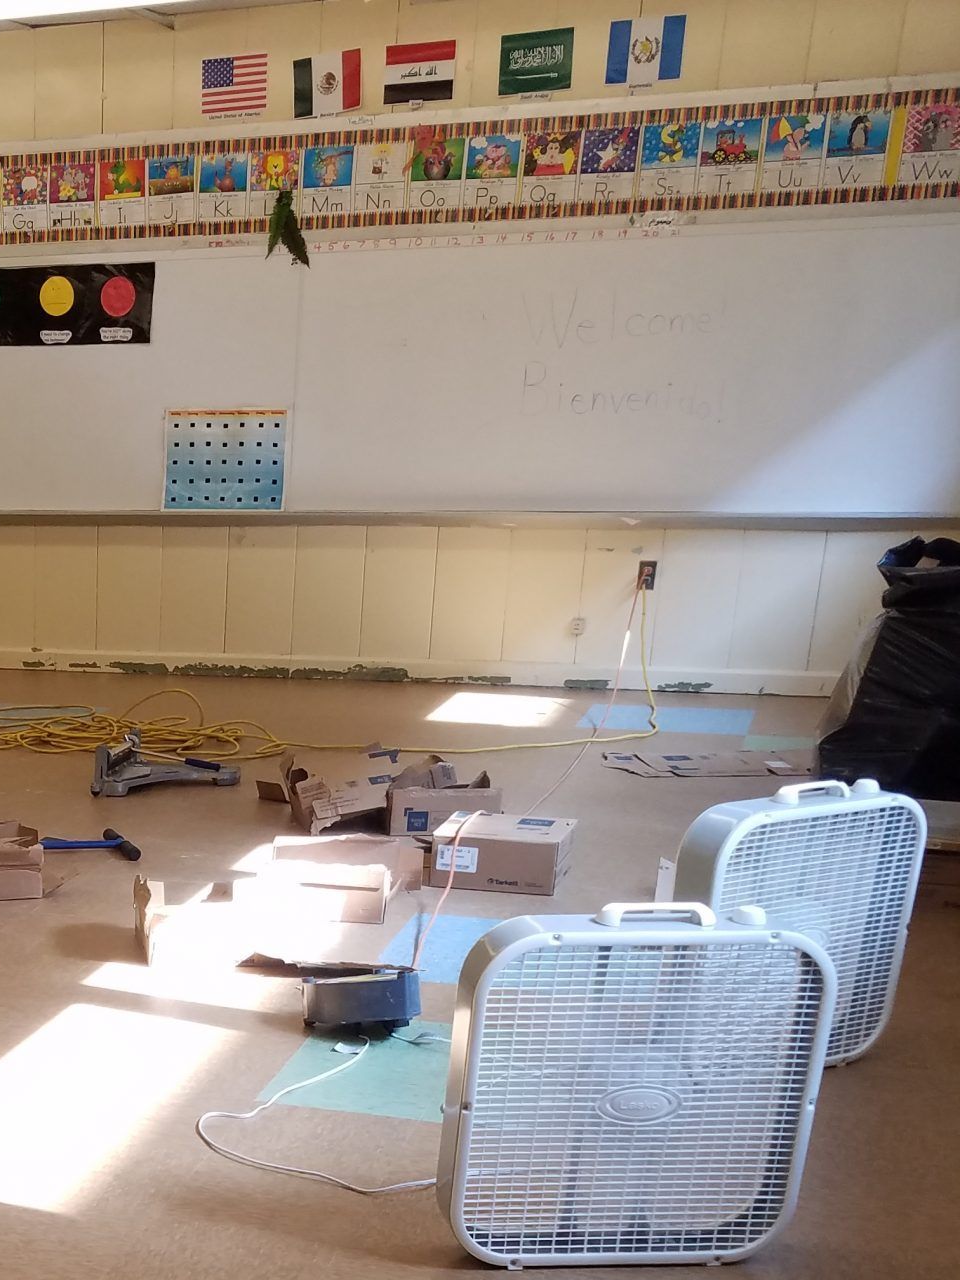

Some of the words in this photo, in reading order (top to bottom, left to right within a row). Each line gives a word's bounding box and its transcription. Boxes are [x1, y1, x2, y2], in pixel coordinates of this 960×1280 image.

[778, 169, 803, 188] Uu
[837, 164, 861, 184] Vv
[912, 160, 953, 181] Ww
[593, 181, 615, 201] Rr
[654, 177, 674, 196] Ss
[714, 173, 732, 193] Tt
[311, 195, 343, 213] Mm
[366, 192, 391, 209] Nn
[419, 189, 446, 207] Oo
[213, 200, 233, 218] Kk
[60, 210, 81, 228] Hh
[408, 236, 423, 248] 10
[447, 236, 461, 246] 12
[495, 233, 507, 244] 14
[520, 231, 535, 243] 15
[618, 1100, 661, 1111] Lasko
